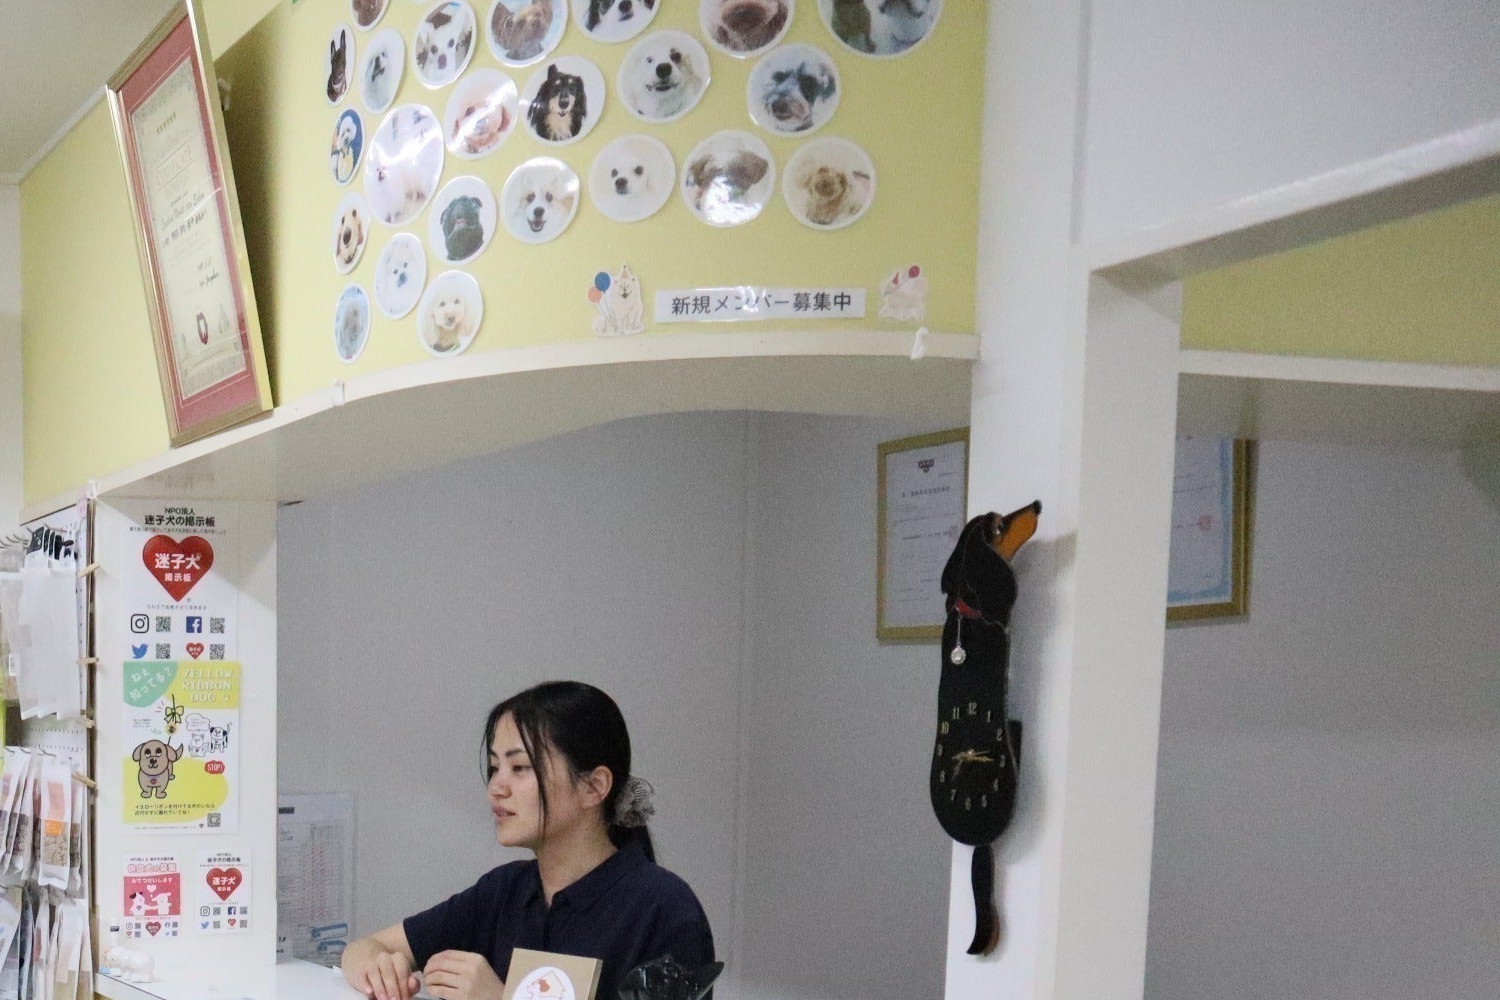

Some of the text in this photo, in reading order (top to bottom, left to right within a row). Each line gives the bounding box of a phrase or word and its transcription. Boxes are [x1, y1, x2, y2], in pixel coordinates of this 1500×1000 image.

[144, 515, 216, 527] 迷子犬の掲示板
[154, 552, 201, 570] 迷子犬
[968, 702, 977, 715] 12
